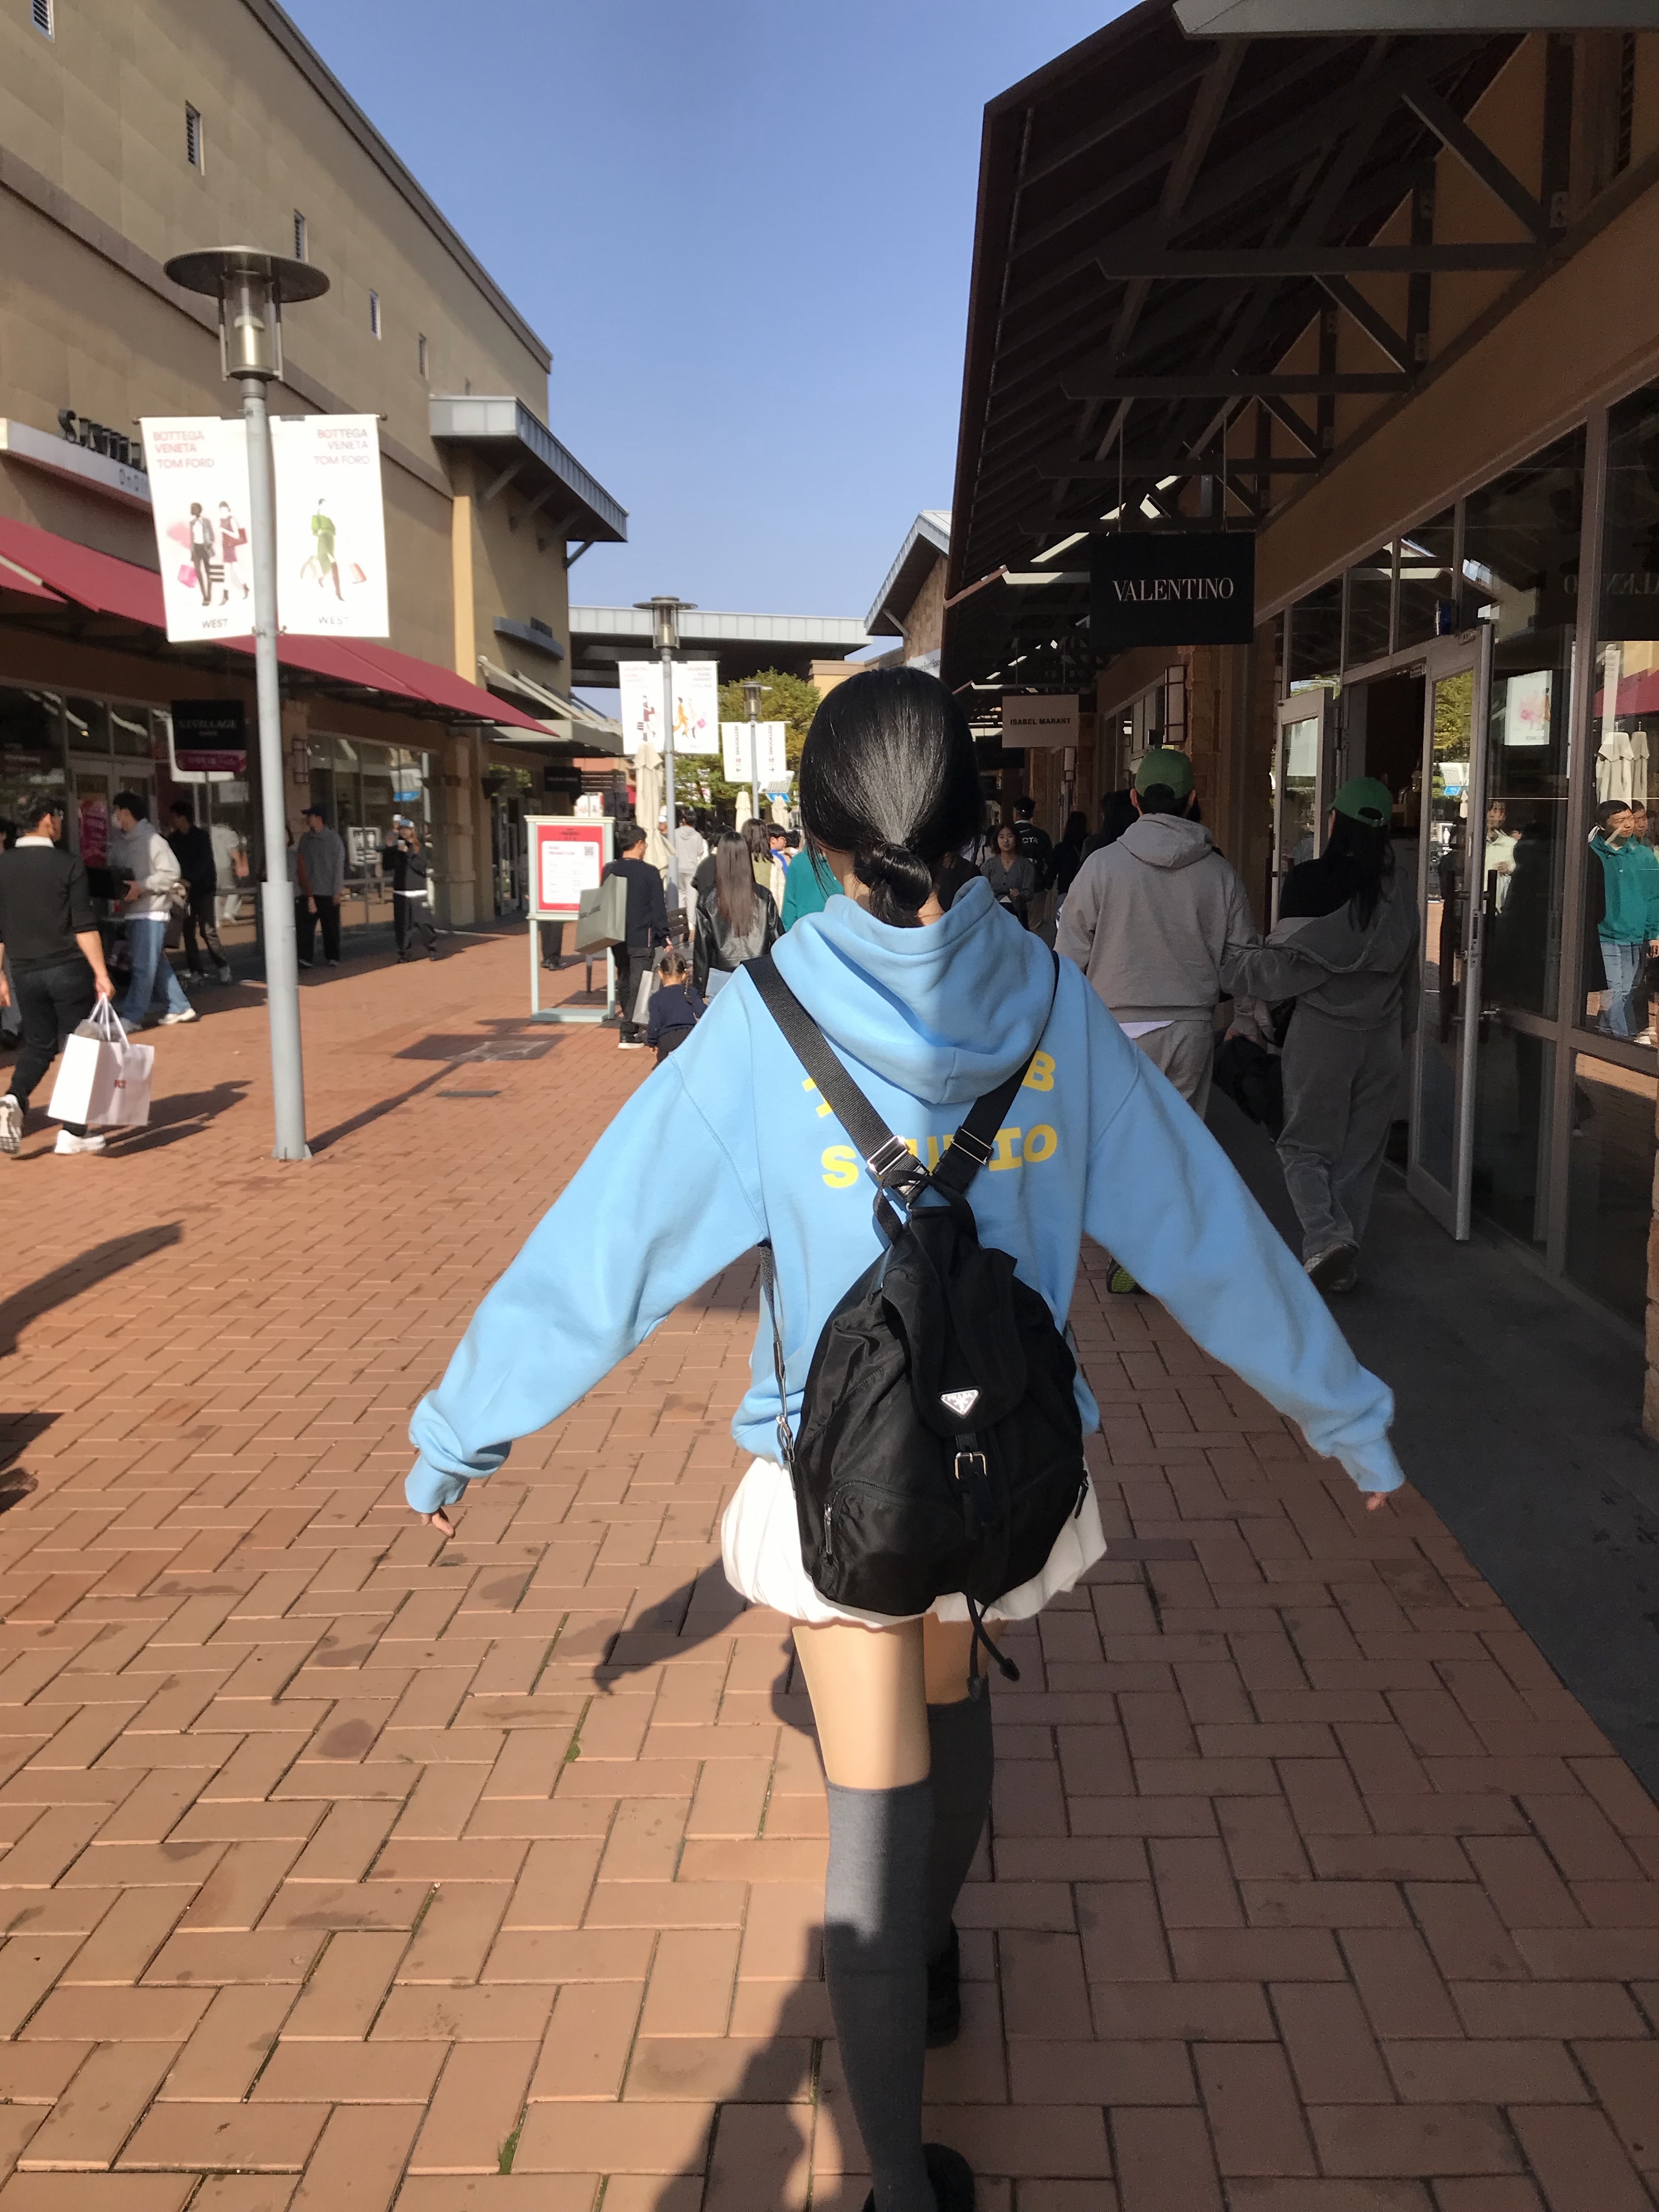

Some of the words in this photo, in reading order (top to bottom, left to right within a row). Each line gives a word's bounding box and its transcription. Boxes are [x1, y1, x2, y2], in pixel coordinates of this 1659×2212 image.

[153, 431, 205, 441] BOTTEGA
[317, 428, 368, 438] BOTTEGA
[154, 443, 198, 453] VENETA
[327, 441, 369, 449] VENETA
[156, 459, 183, 469] TOM
[185, 458, 215, 468] FORD
[313, 456, 339, 465] TOM
[341, 455, 370, 464] FORD
[1112, 577, 1234, 602] VALENTINO
[202, 618, 228, 628] WEST
[318, 616, 349, 625] WEST
[947, 1392, 974, 1402] PRADA
